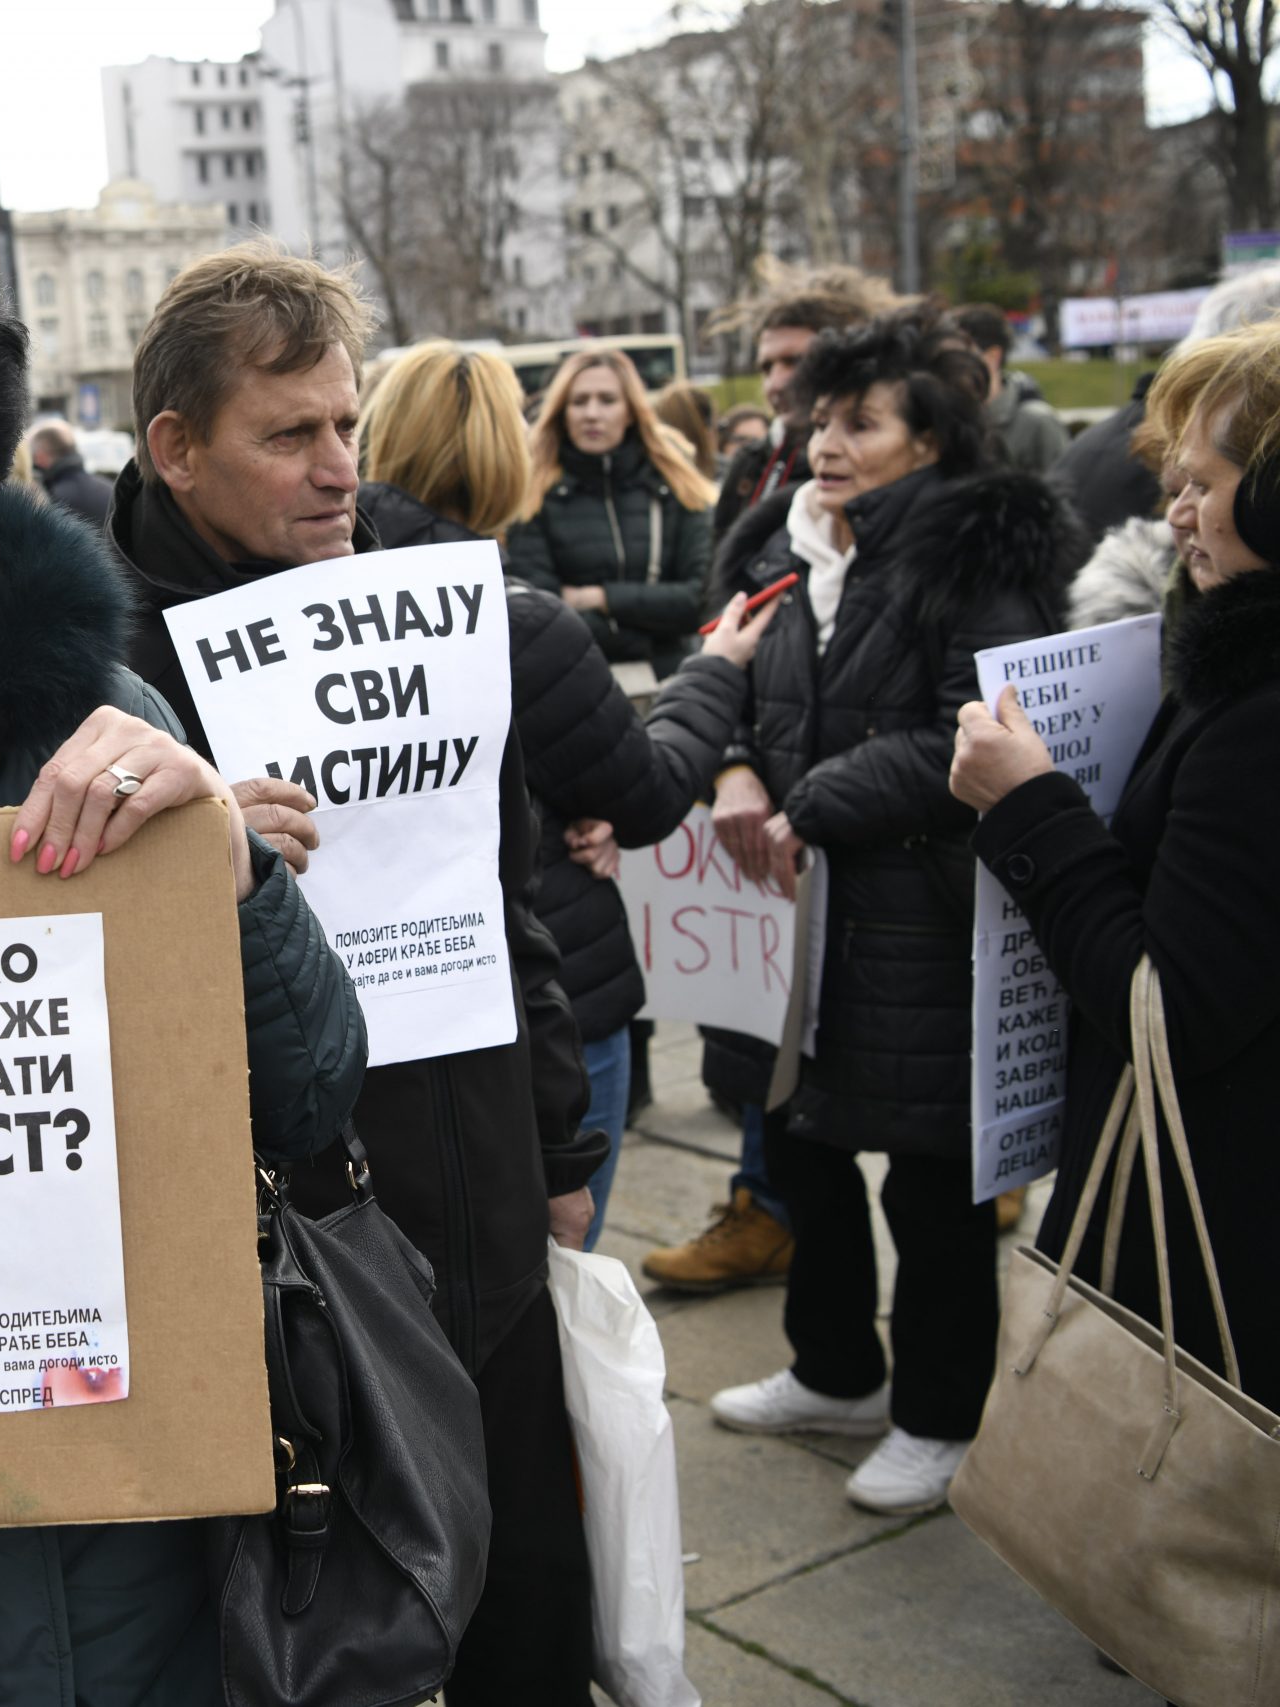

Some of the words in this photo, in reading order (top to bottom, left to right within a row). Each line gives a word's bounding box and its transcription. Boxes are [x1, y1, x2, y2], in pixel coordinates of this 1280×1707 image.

[195, 617, 287, 683] НЕ
[301, 584, 484, 651] ЗНАЈУ
[1003, 643, 1102, 681] РЕШИТЕ
[314, 664, 430, 725] СВИ
[1032, 707, 1086, 735] ФЕРУ
[1047, 736, 1091, 764] ШОЈ
[335, 924, 398, 949] ПОМОЗИТЕ
[401, 911, 485, 939] РОДИТЕЉИМА
[1001, 930, 1037, 957] ДР
[347, 953, 354, 969] У
[357, 946, 398, 968] АФЕРИ
[401, 939, 441, 961] КРАЂЕ
[444, 934, 476, 953] БЕБА
[352, 973, 375, 989] кајте
[378, 972, 389, 986] да
[392, 969, 403, 980] се
[406, 967, 412, 978] и
[415, 965, 438, 977] вама
[440, 960, 473, 976] догоди
[477, 954, 497, 967] исто
[999, 981, 1047, 1008] ВЕЋ
[998, 1003, 1059, 1035] КАЖЕ
[996, 1042, 1010, 1062] И
[1018, 1030, 1061, 1056] КОД
[995, 1054, 1068, 1090] ЗАВРШ
[996, 1083, 1057, 1117] НАША
[999, 1114, 1061, 1151] ОТЕТА
[46, 1331, 89, 1348] БЕБА
[4, 1359, 35, 1371] вама
[39, 1356, 85, 1372] догоди
[89, 1354, 118, 1365] исто
